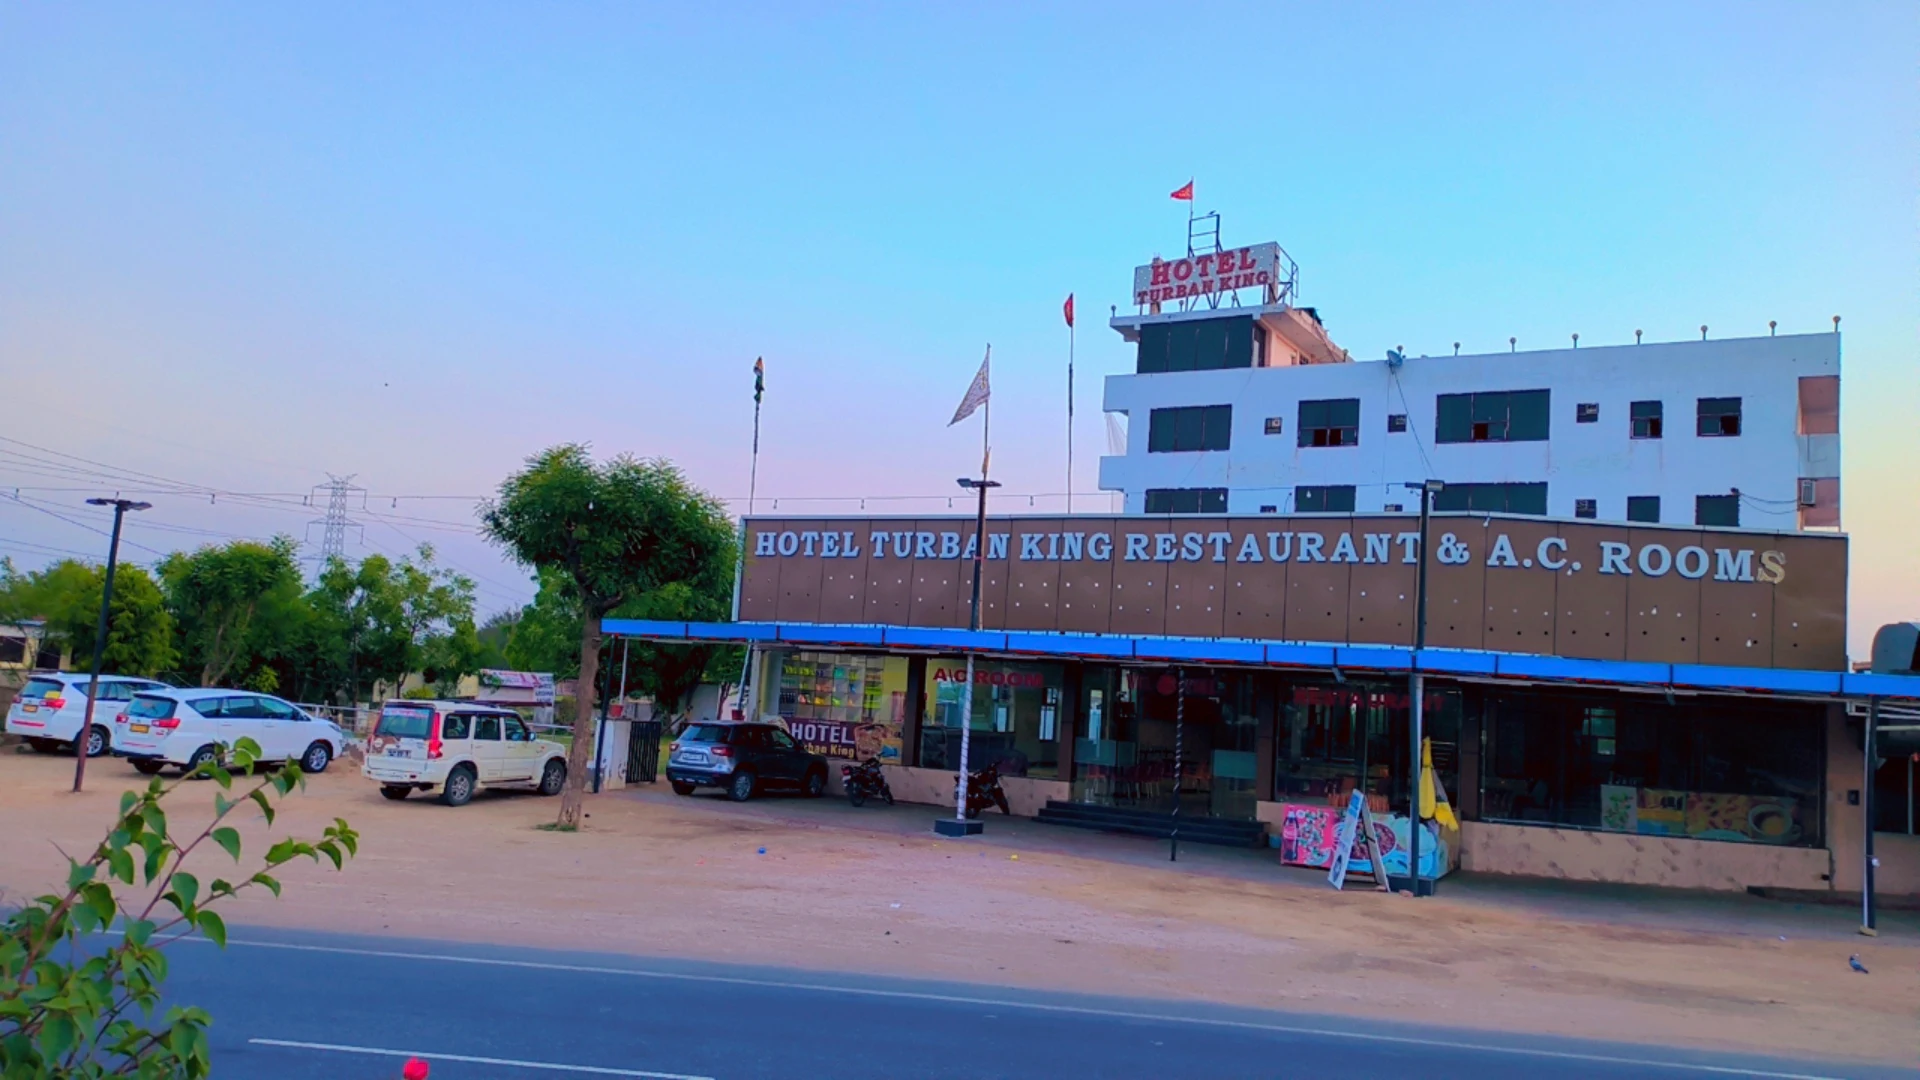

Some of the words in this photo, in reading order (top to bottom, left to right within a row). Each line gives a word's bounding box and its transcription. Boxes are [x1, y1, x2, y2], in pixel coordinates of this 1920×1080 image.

[1151, 248, 1256, 285] HOTEL
[1137, 279, 1214, 304] TURBAN
[1219, 271, 1269, 290] KING
[755, 531, 860, 557] HOTEL
[870, 531, 1010, 560] TURBAN
[1019, 533, 1113, 561] KING
[1124, 532, 1421, 563] RESTAURANT
[1436, 532, 1470, 564] &
[1487, 534, 1582, 571] A.C.
[1599, 541, 1787, 584] ROOMS
[974, 669, 1044, 688] ROOM
[791, 722, 855, 744] HOTEL
[830, 744, 855, 759] King
